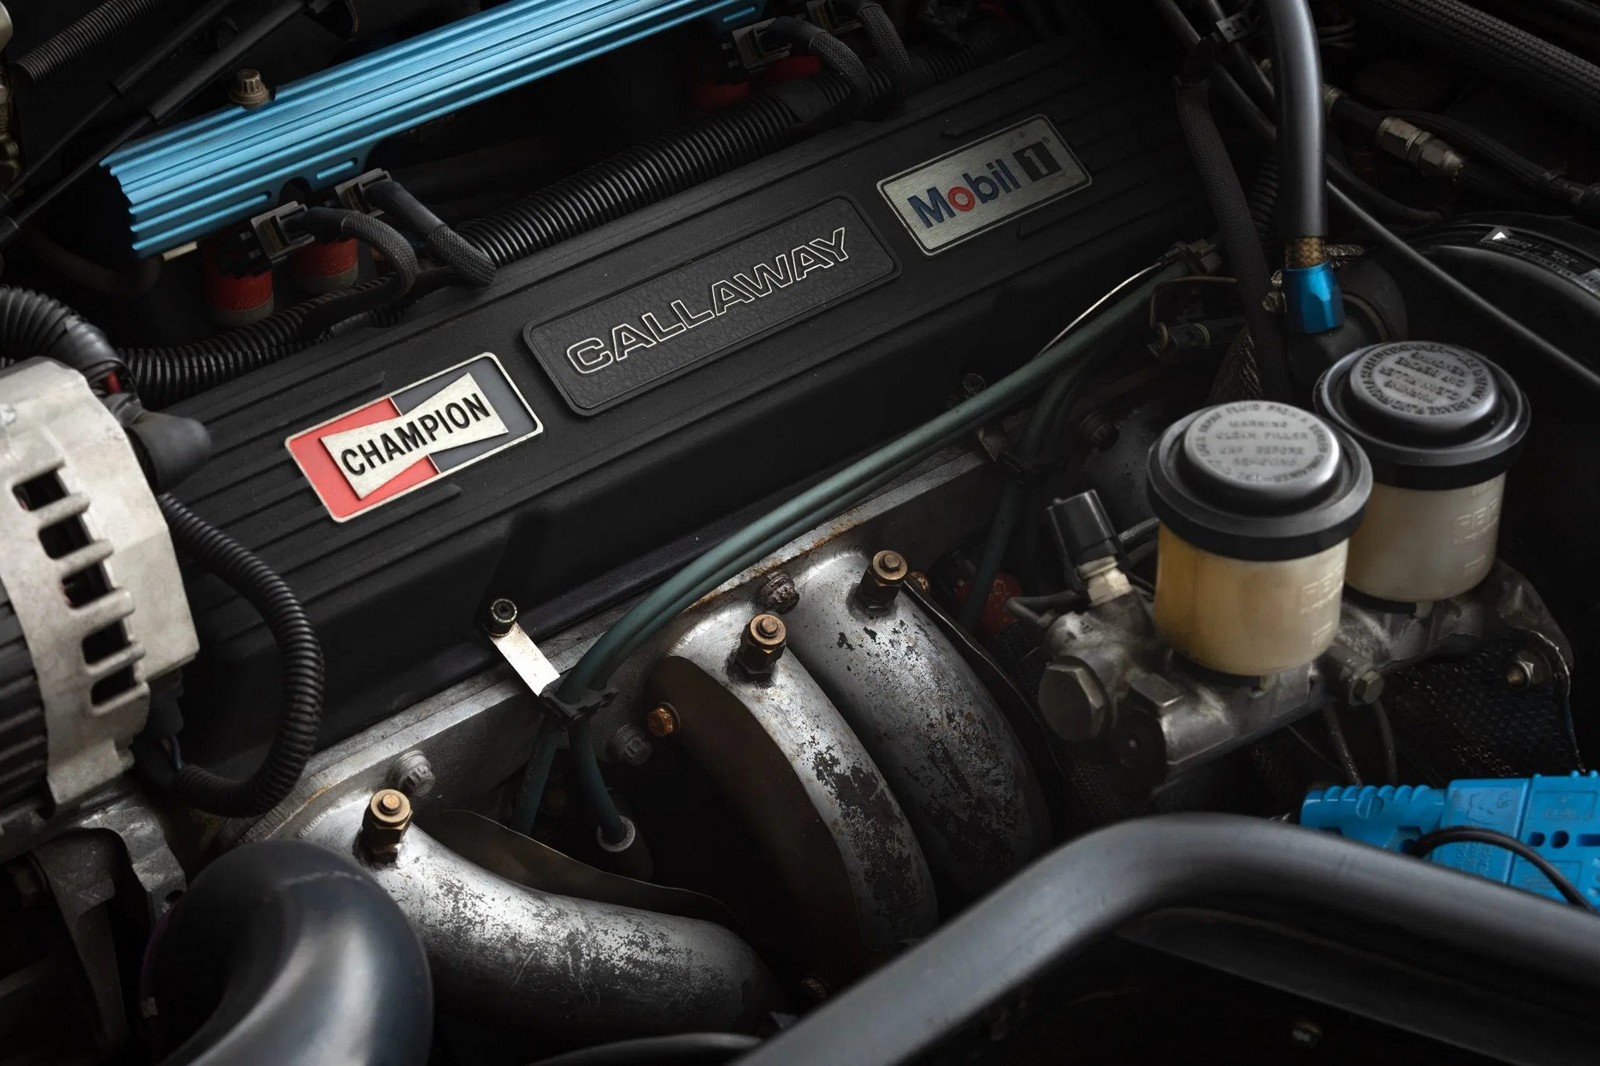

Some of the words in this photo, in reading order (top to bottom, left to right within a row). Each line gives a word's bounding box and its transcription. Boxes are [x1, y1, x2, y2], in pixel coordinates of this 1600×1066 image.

[907, 158, 1021, 229] Mobil
[566, 226, 849, 375] CALLAWAY
[340, 392, 491, 477] CHAMPION
